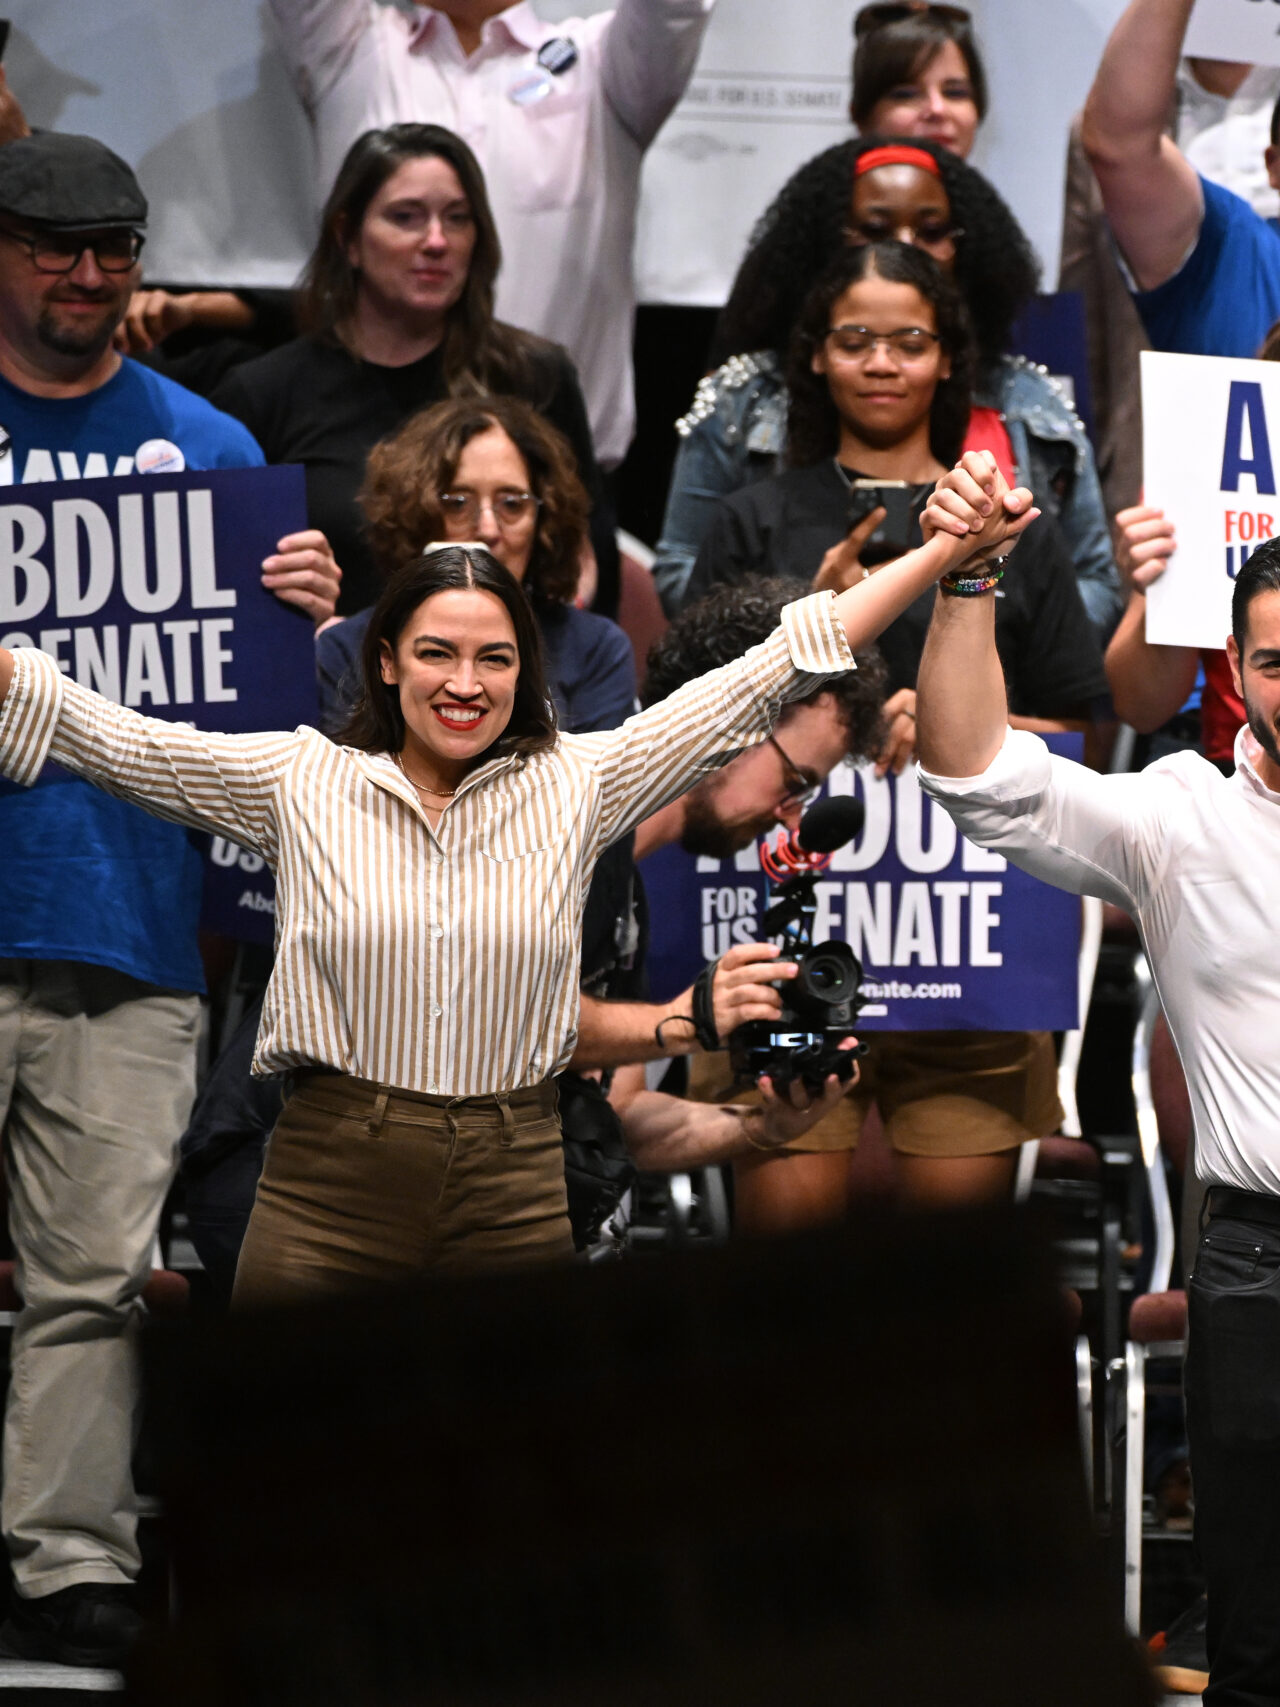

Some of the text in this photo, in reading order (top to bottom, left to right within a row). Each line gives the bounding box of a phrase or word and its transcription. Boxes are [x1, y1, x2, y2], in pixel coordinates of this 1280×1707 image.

[0, 489, 237, 624] BDUL
[1225, 510, 1274, 542] FOR
[701, 885, 758, 924] FOR
[768, 881, 1003, 967] ENATE
